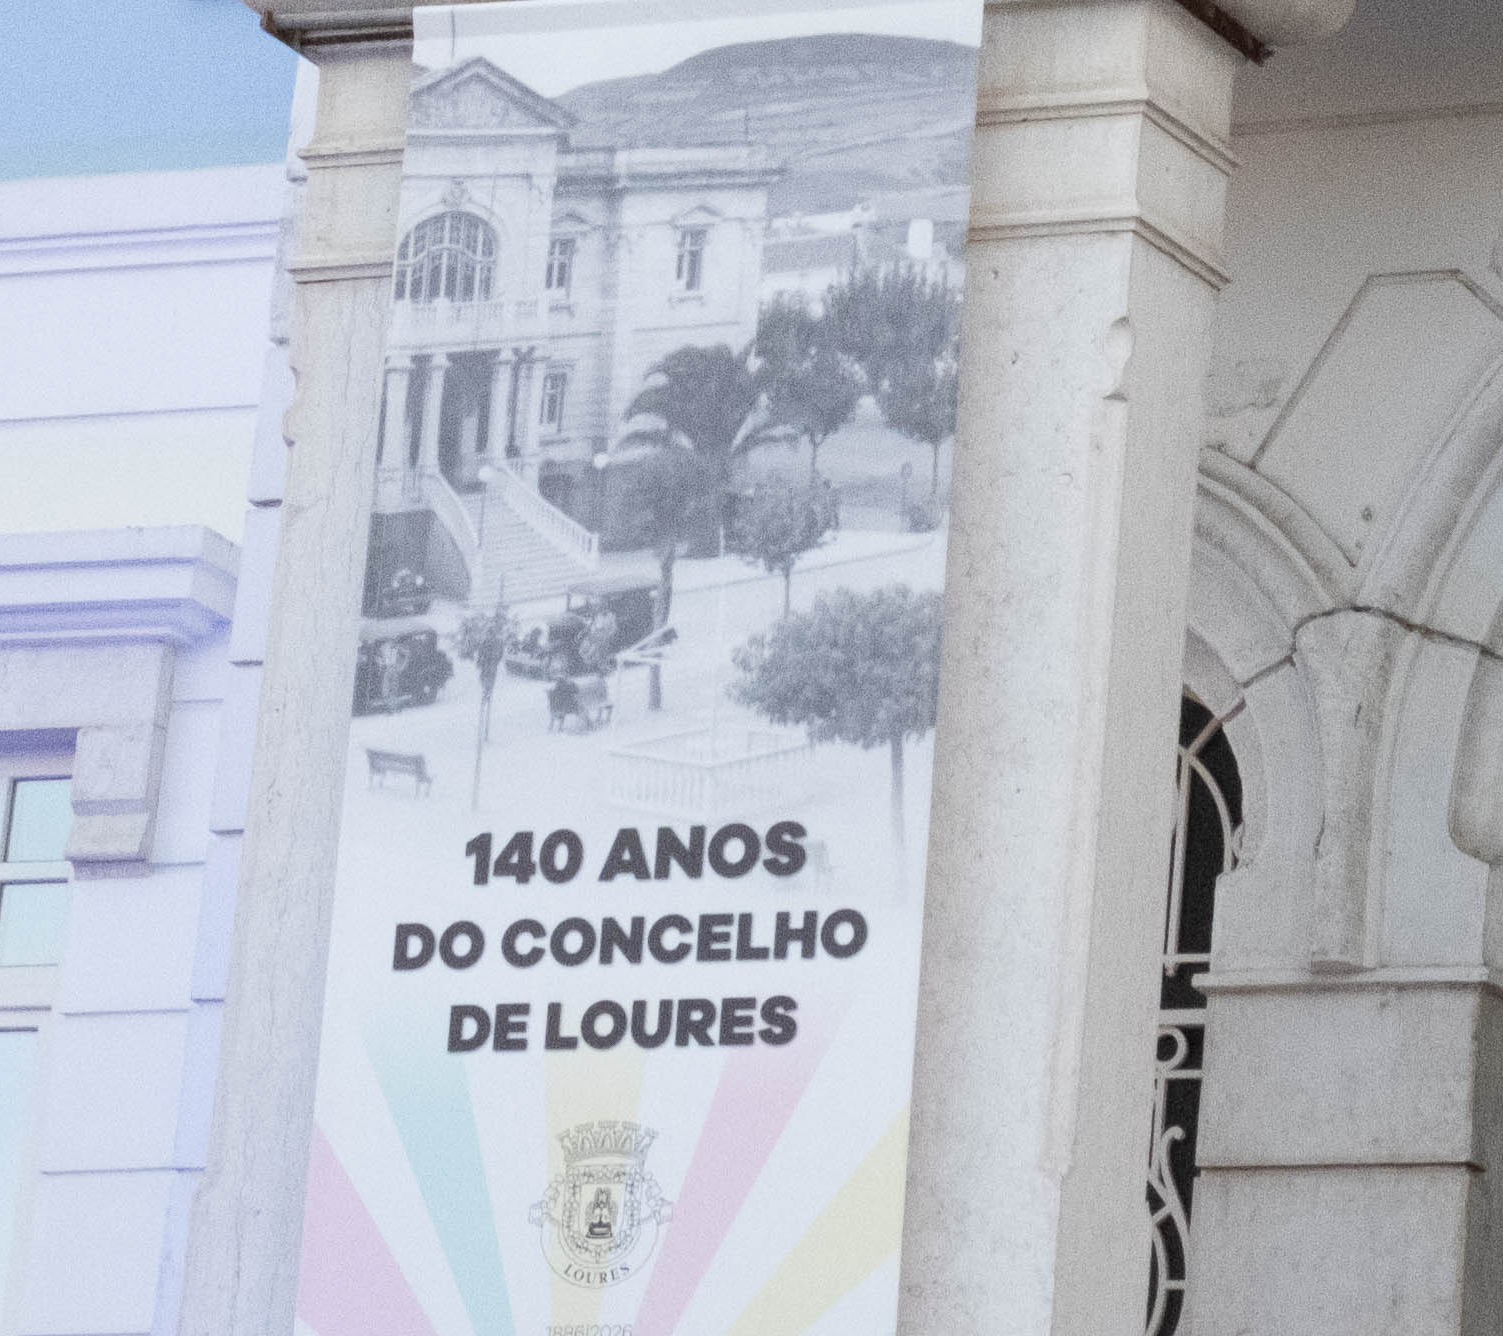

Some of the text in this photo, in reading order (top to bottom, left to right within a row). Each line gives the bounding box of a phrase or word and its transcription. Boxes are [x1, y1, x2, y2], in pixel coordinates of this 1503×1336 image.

[464, 819, 809, 886] 140 ANOS
[392, 908, 870, 972] DO CONCELHO
[446, 994, 799, 1054] DE LOURES
[563, 1263, 631, 1285] LOURES
